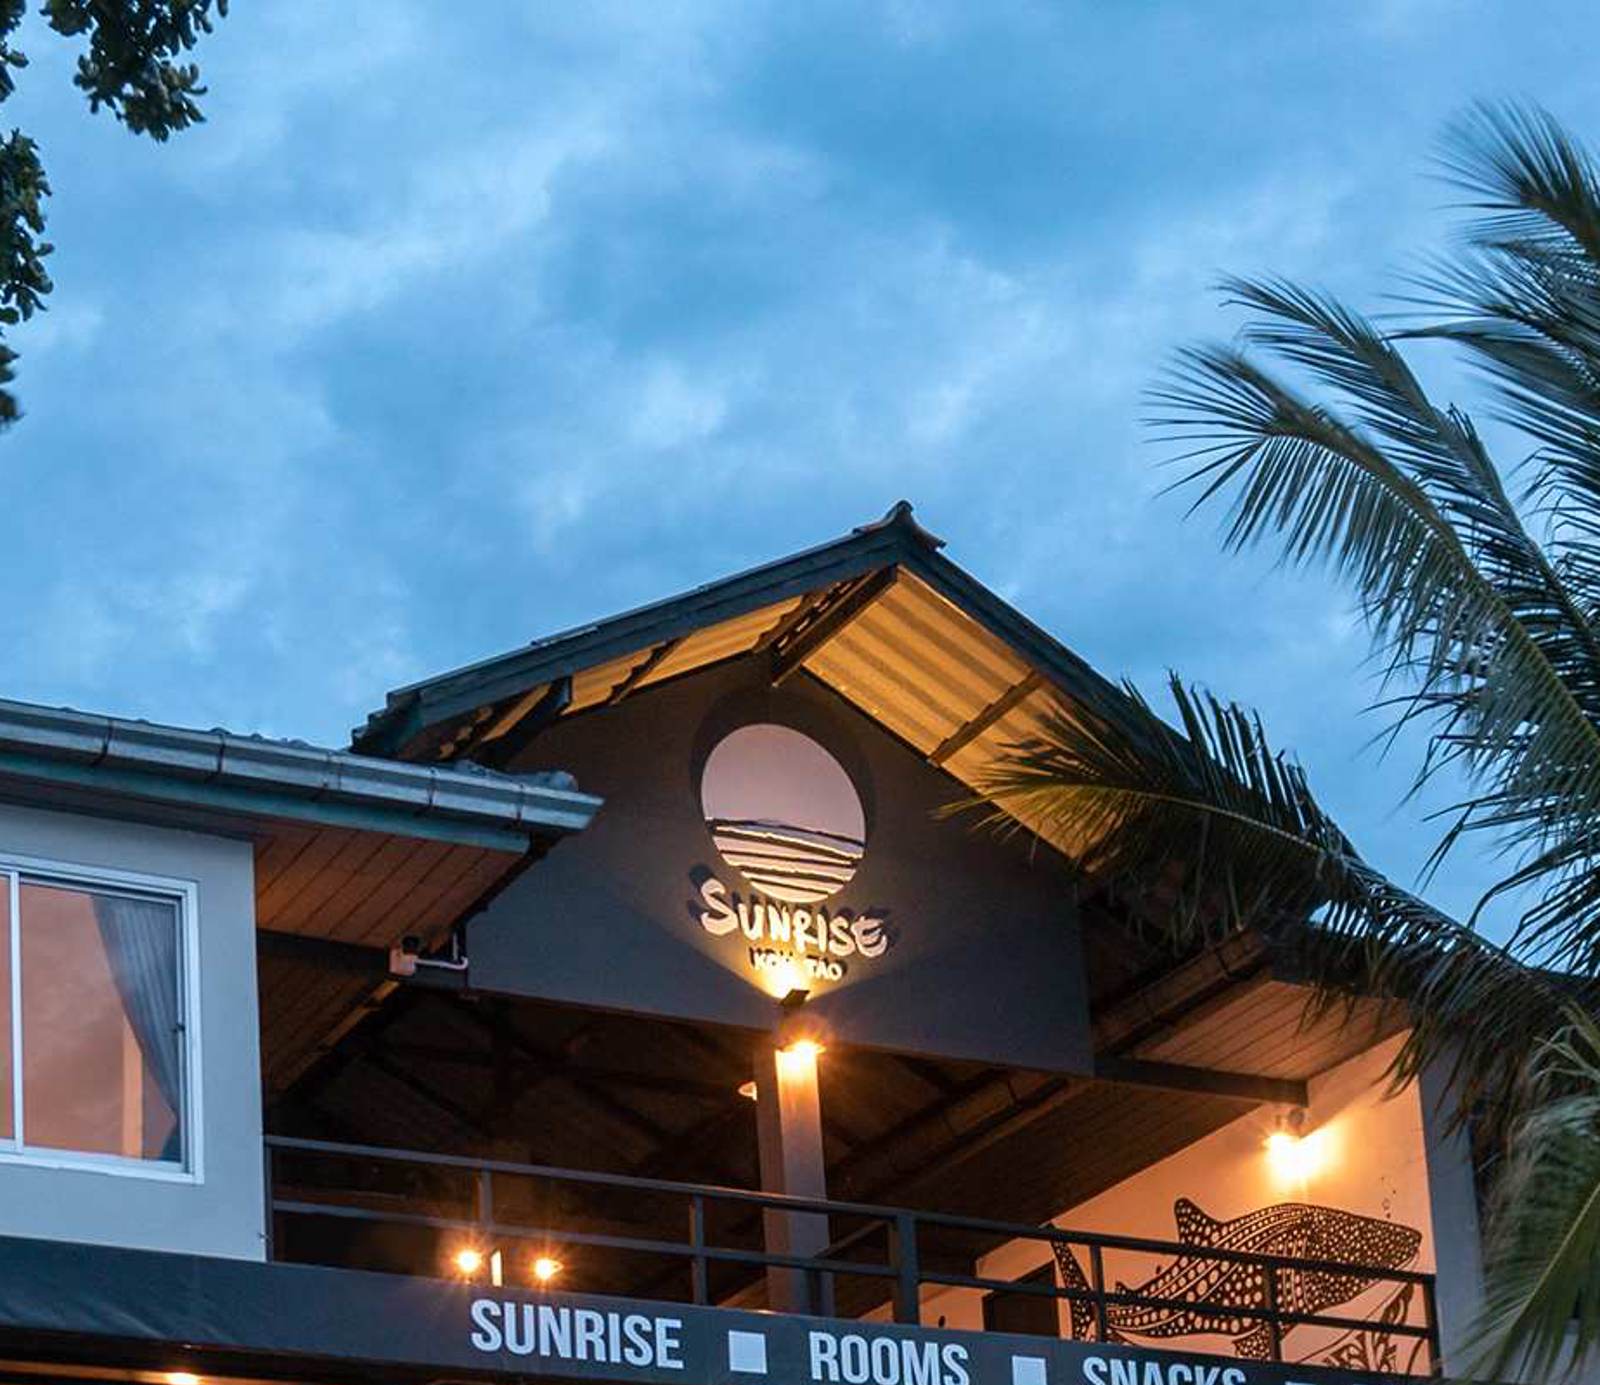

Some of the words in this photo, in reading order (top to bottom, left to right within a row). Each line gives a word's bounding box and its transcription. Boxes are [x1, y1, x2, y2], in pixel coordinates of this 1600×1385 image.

[701, 878, 888, 957] SUNRISE
[803, 957, 842, 981] TAO
[470, 1300, 684, 1369] SUNRISE
